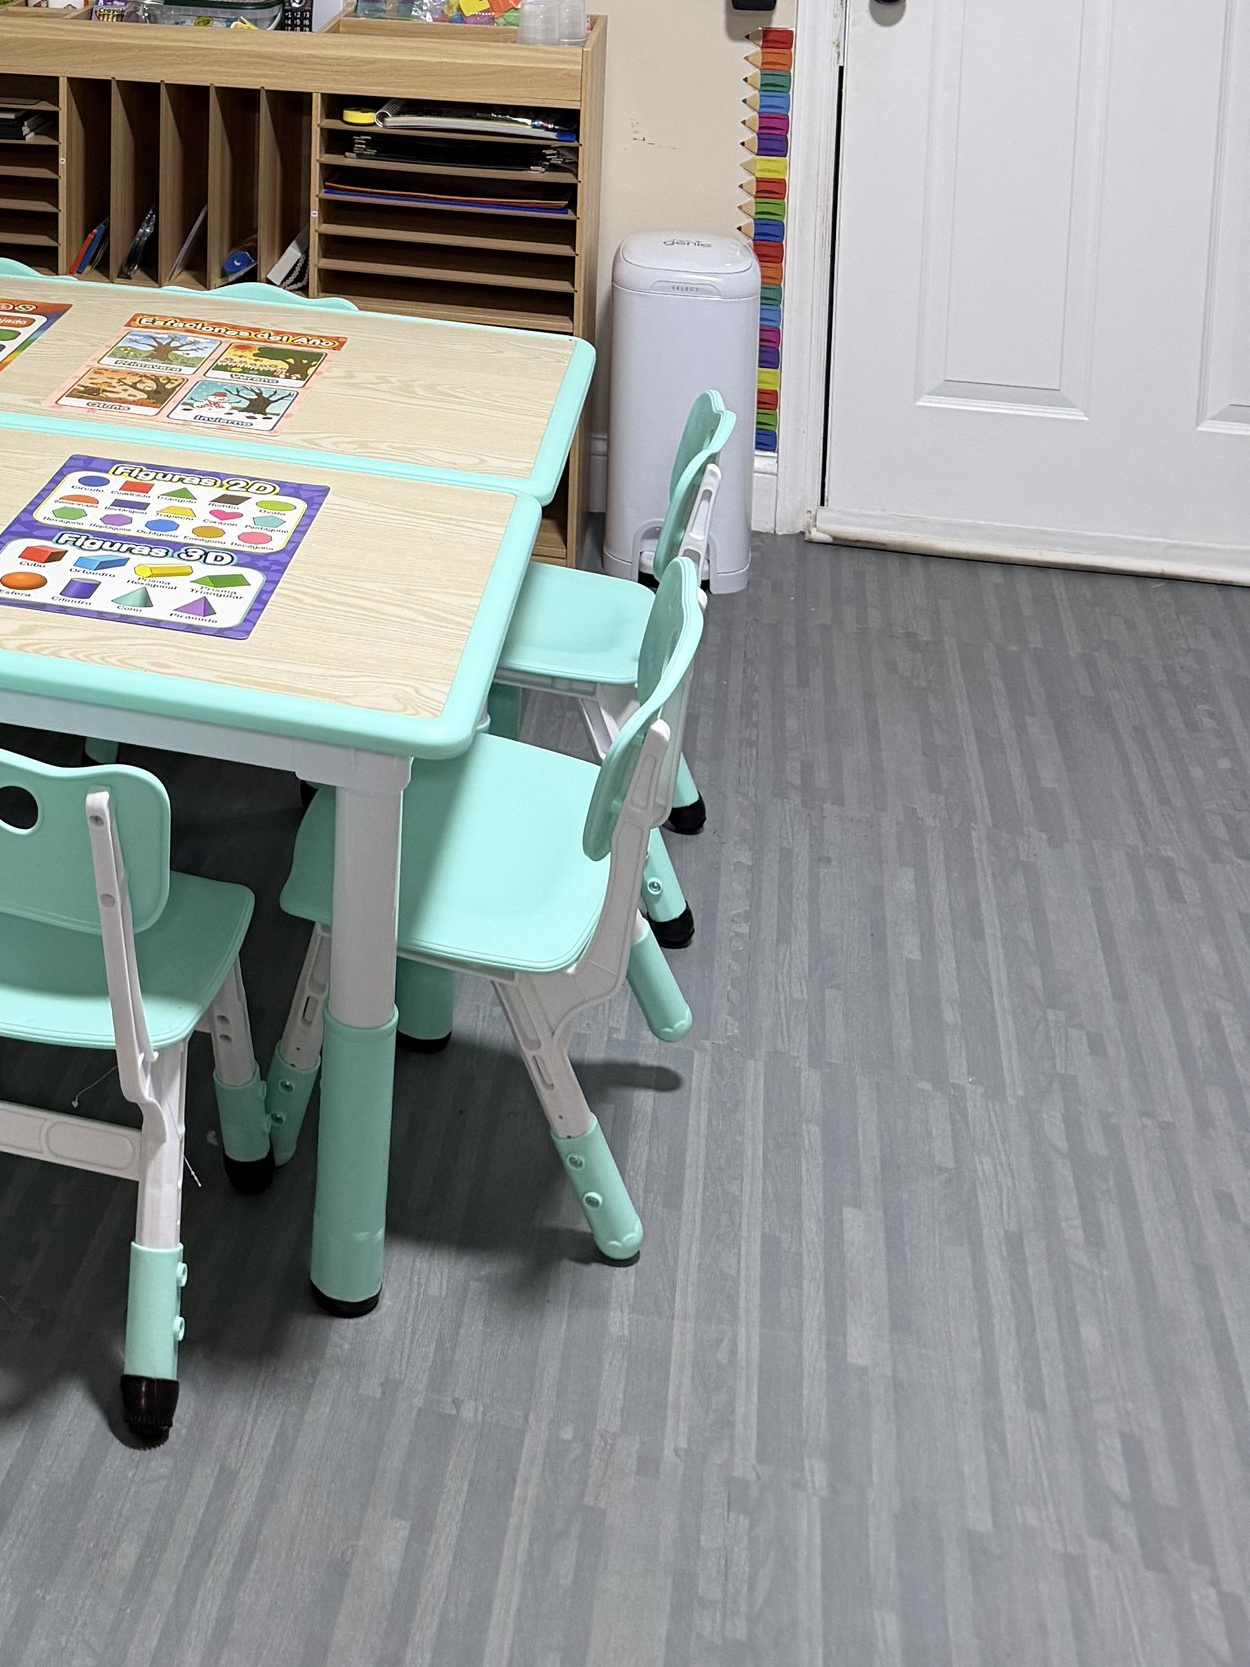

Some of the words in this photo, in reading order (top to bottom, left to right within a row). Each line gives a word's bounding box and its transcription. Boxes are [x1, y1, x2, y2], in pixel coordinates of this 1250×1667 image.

[663, 238, 712, 248] genie
[137, 316, 253, 339] Estaciones
[254, 331, 290, 344] del
[113, 465, 219, 489] Figuras
[225, 479, 277, 496] 2D
[55, 532, 171, 559] Figuras
[177, 547, 235, 566] 3D
